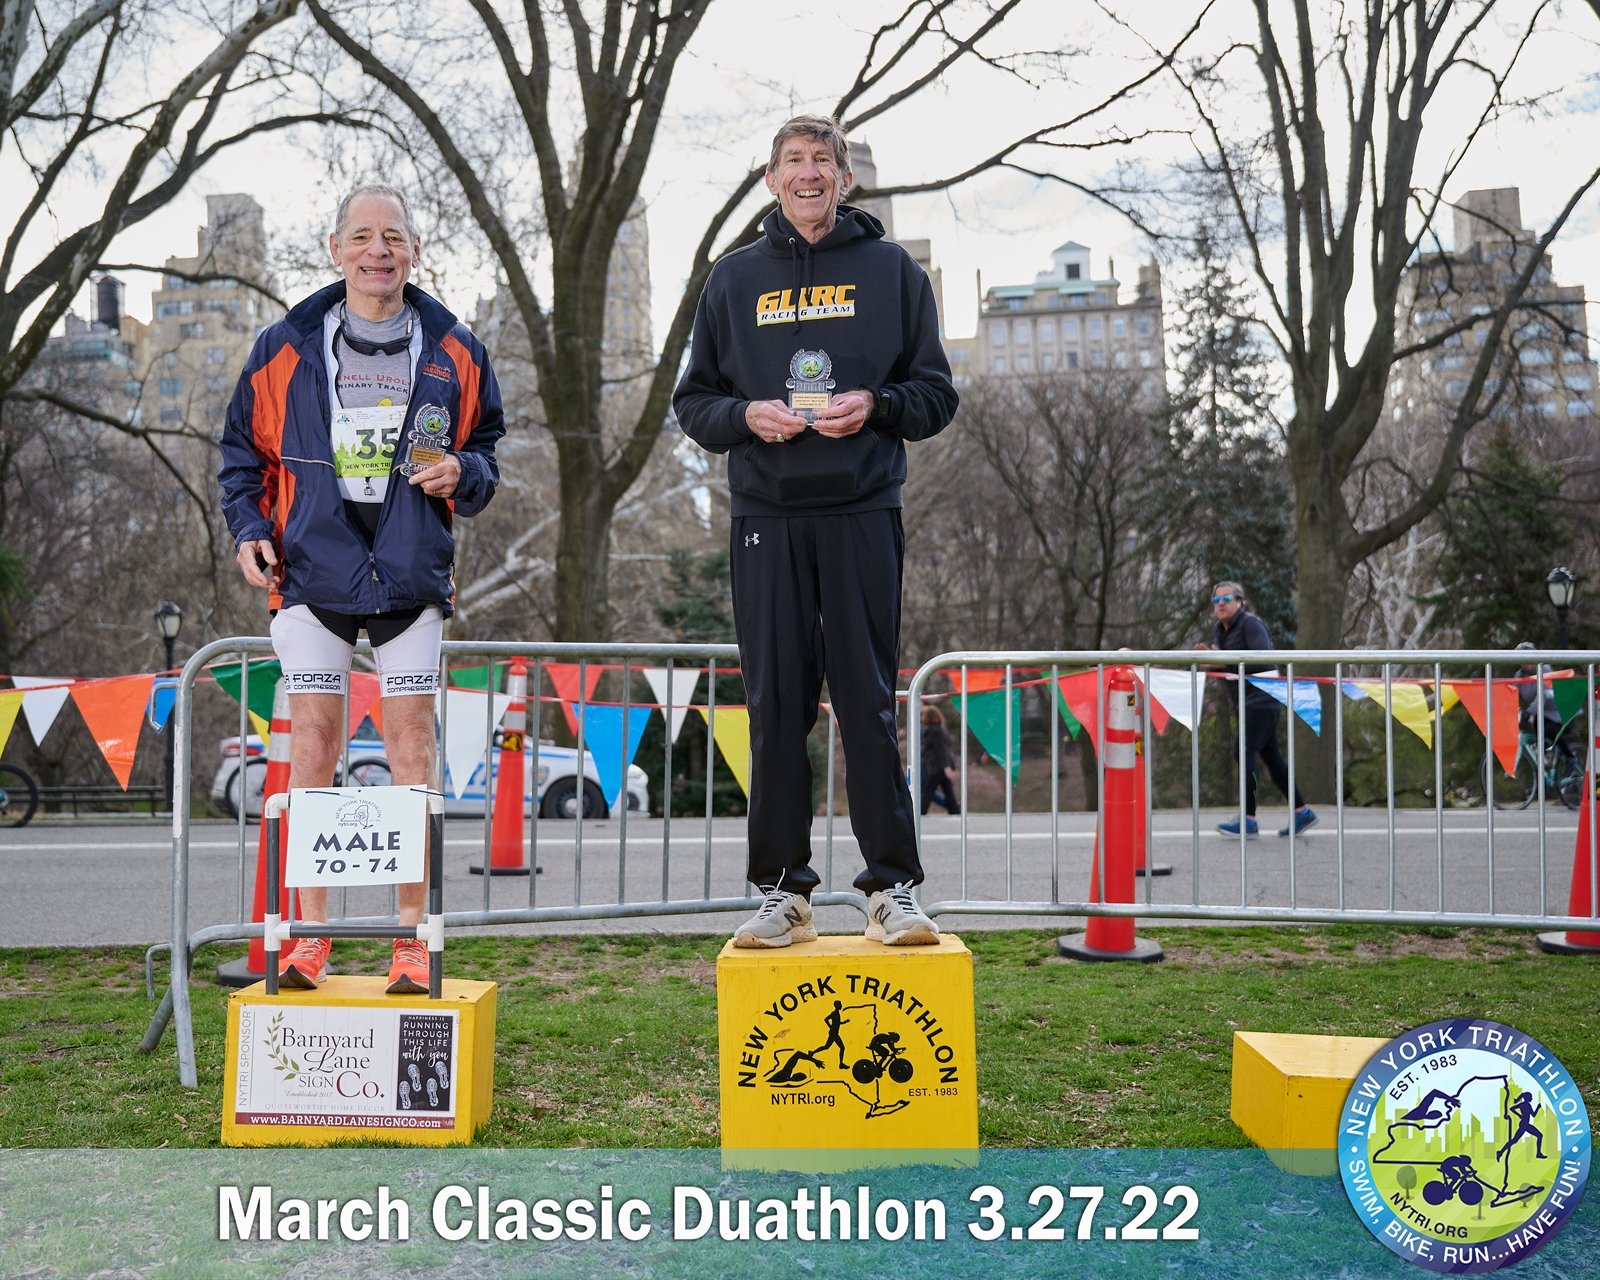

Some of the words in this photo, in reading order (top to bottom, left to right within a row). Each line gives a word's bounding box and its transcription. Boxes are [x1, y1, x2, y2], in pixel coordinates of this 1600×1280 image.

[815, 306, 850, 316] TEAM
[292, 673, 341, 684] FORZA
[386, 674, 433, 686] FORZA
[386, 685, 433, 693] COMPRESSOR
[342, 799, 358, 808] YORK
[359, 799, 382, 818] TRIATHLON
[312, 830, 401, 853] MALE
[403, 1021, 449, 1030] RUNNING
[738, 1025, 769, 1088] NEW
[764, 975, 837, 1022] YORK
[845, 974, 959, 1084] TRIATHLON
[240, 1010, 252, 1068] SPONSOR
[281, 1027, 374, 1051] Barnyard
[403, 1030, 450, 1038] THROUGH
[403, 1038, 425, 1046] THIS
[428, 1039, 448, 1047] LIFE
[304, 1047, 370, 1074] Lane
[402, 1045, 425, 1062] with
[427, 1050, 449, 1068] you
[239, 1071, 249, 1106] NYTRI
[298, 1075, 334, 1089] SIGN
[336, 1070, 385, 1099] Co.
[908, 1088, 931, 1097] EST.
[935, 1087, 958, 1096] 1983
[265, 1103, 328, 1111] QUOTEWORTHY
[771, 1093, 836, 1107] NYTRI.org
[250, 1114, 441, 1128] www.BARNYARDLANESIGNCO.com
